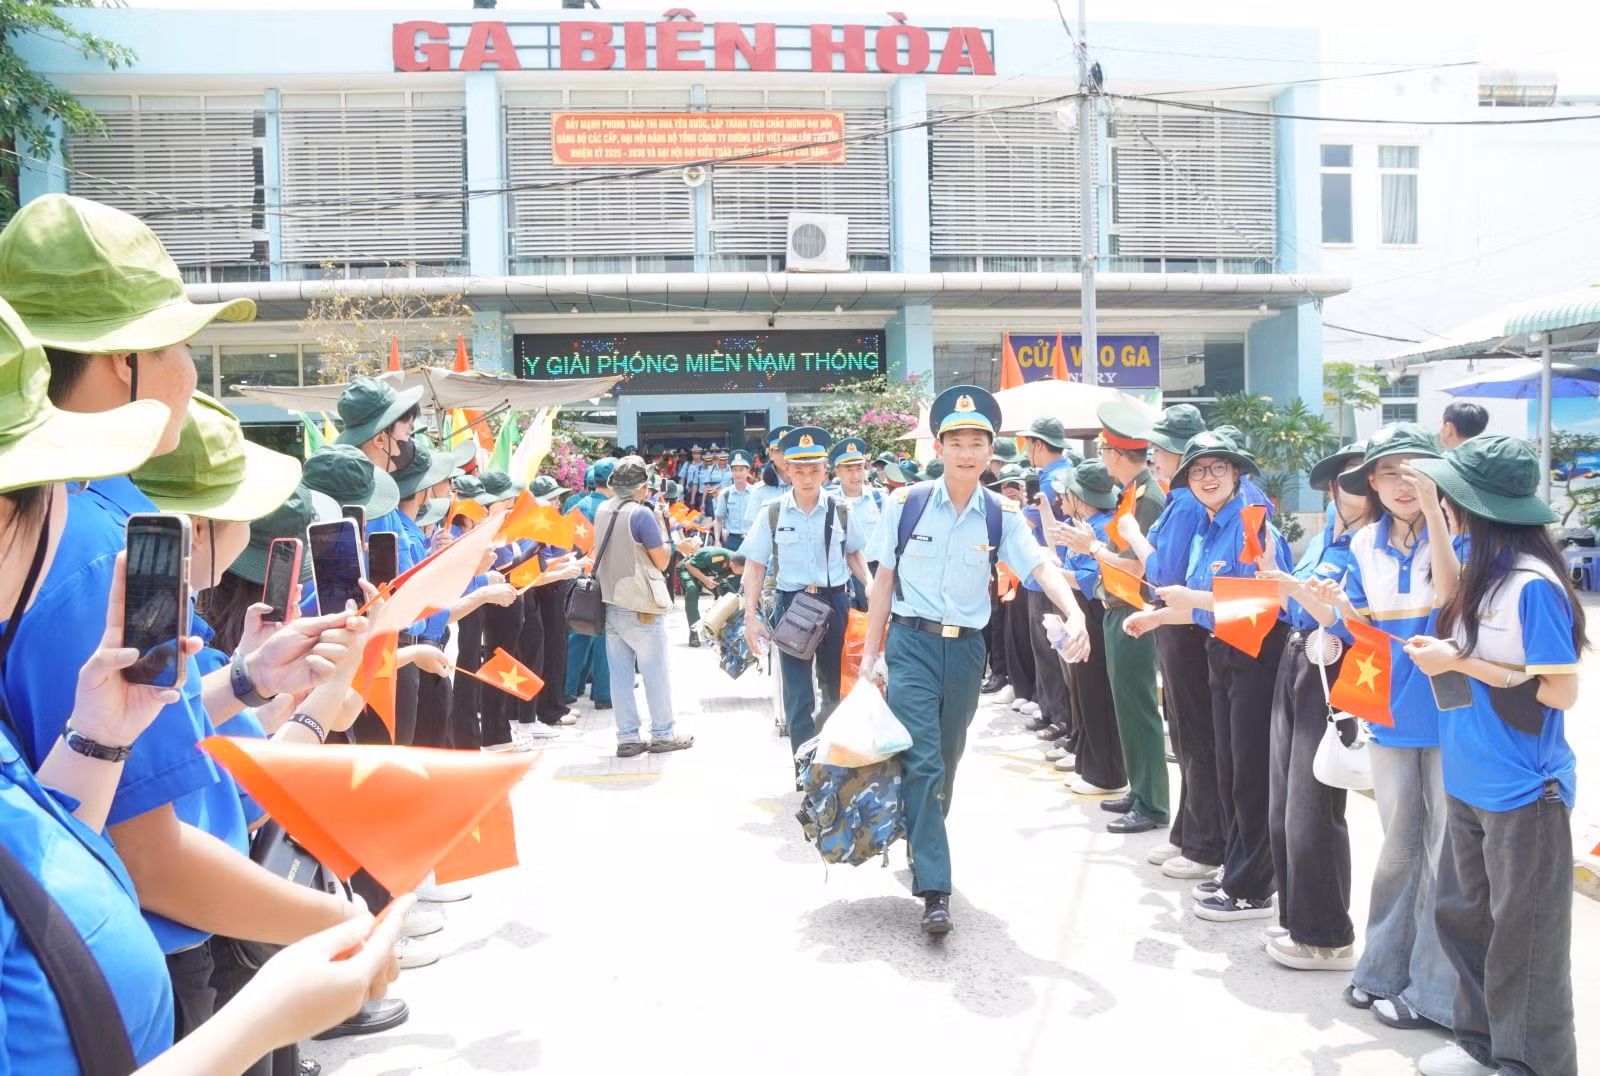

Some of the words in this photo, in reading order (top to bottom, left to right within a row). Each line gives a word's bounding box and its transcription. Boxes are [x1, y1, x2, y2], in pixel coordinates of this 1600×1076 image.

[393, 21, 521, 71] GA
[560, 8, 776, 71] BIÊN
[811, 12, 996, 75] HÒA
[602, 119, 626, 129] PHONG
[647, 119, 658, 129] THI
[588, 132, 603, 144] CÁC
[718, 133, 727, 143] TY
[605, 148, 621, 158] 2025
[524, 357, 540, 376] Y
[747, 353, 795, 372] NAM
[1071, 345, 1116, 368] VO
[1121, 345, 1152, 368] GA
